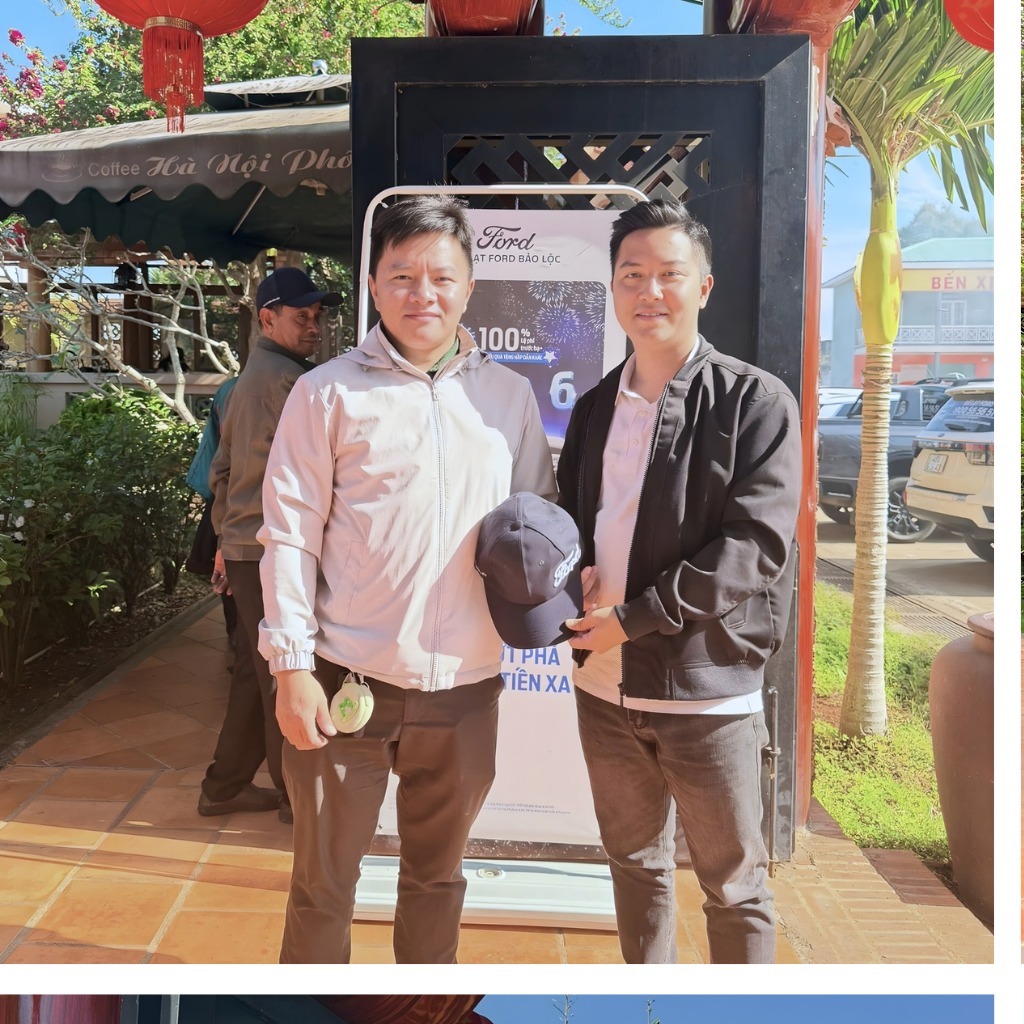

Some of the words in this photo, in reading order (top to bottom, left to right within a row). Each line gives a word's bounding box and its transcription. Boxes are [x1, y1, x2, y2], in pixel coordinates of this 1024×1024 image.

[88, 161, 139, 178] Coffee
[145, 155, 197, 178] Hà
[208, 152, 271, 180] Nội
[477, 225, 536, 250] Ford
[474, 255, 486, 264] ẠT
[519, 252, 538, 263] BẢO
[543, 253, 560, 265] LỘC
[931, 270, 966, 289] BẾN
[479, 327, 519, 352] 100
[521, 329, 530, 337] %
[545, 675, 570, 693] XA
